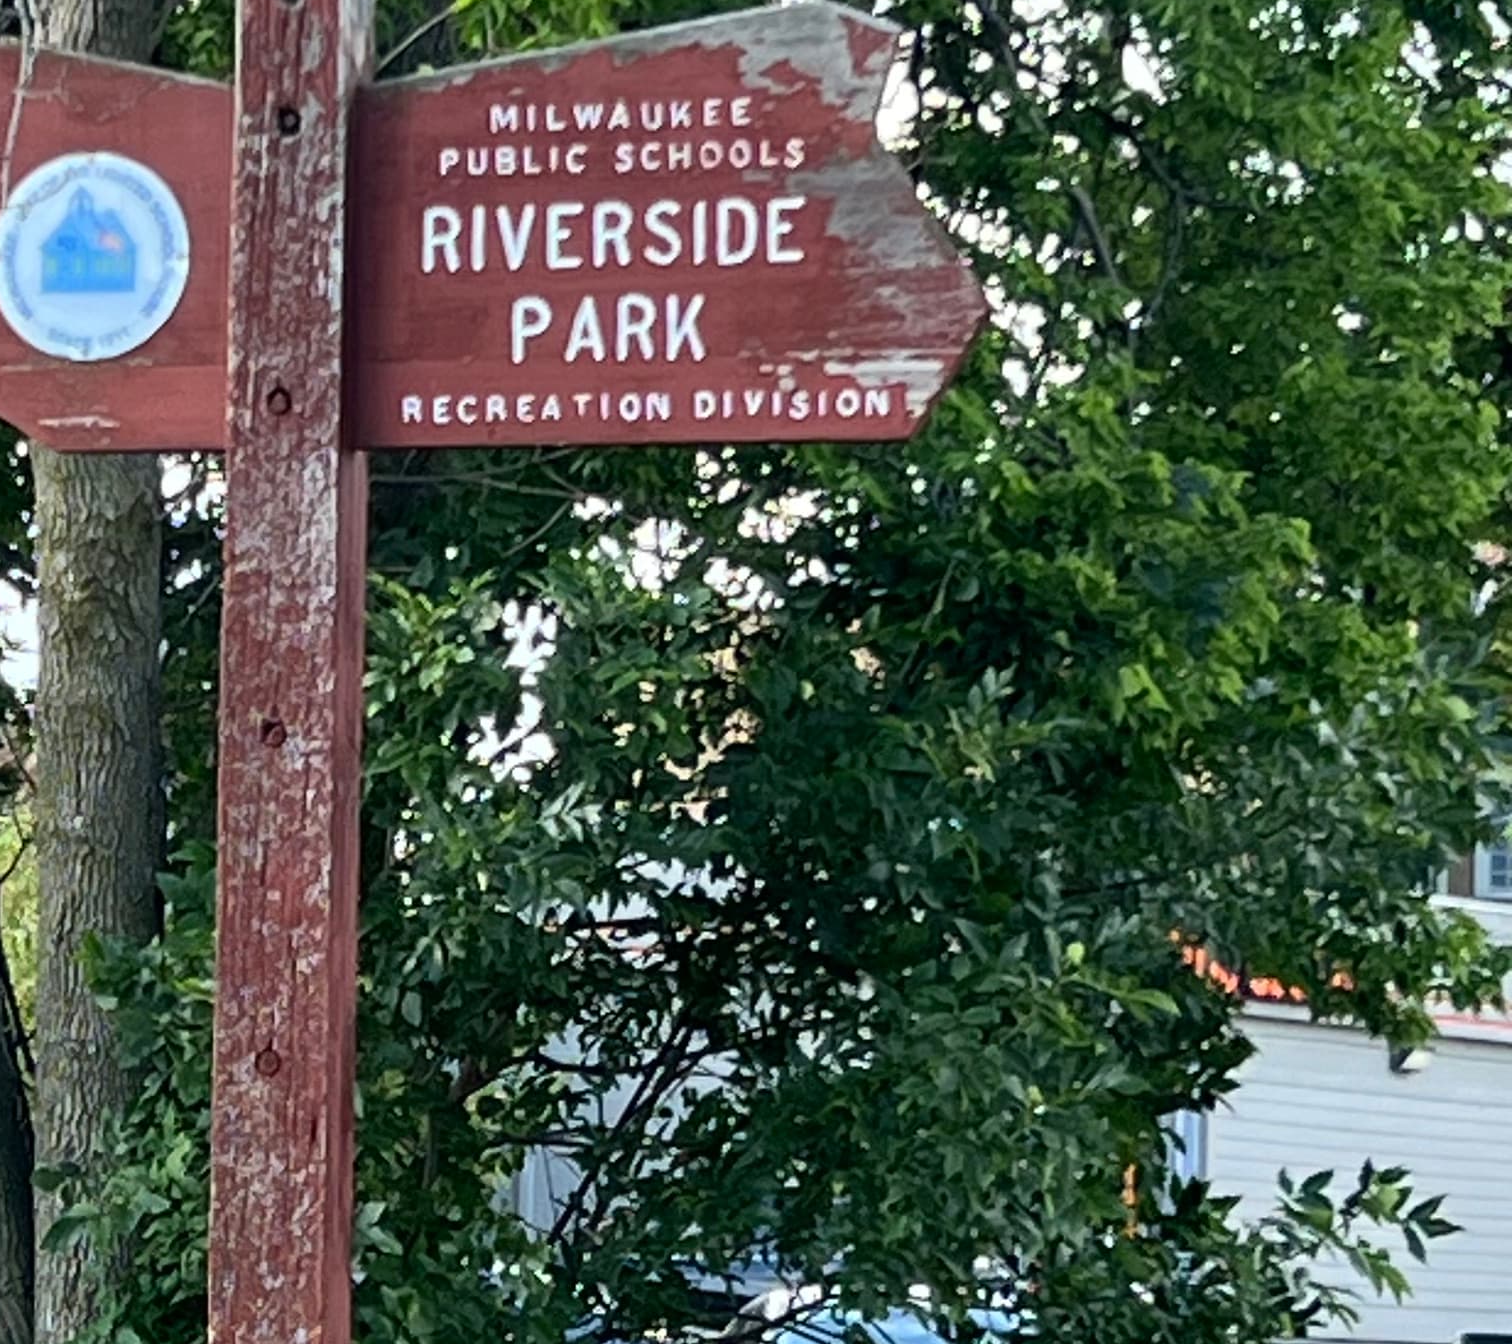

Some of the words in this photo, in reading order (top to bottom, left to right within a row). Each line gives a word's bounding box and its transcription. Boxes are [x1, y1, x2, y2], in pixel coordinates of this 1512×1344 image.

[489, 96, 752, 133] MILWAUKEE
[438, 144, 588, 177] PUBLIC
[614, 138, 806, 173] SCHOOLS
[421, 195, 807, 274] RIVERSIDE
[510, 292, 706, 364] PARK
[401, 392, 672, 425] RECREATION
[693, 388, 891, 420] DIVISION
